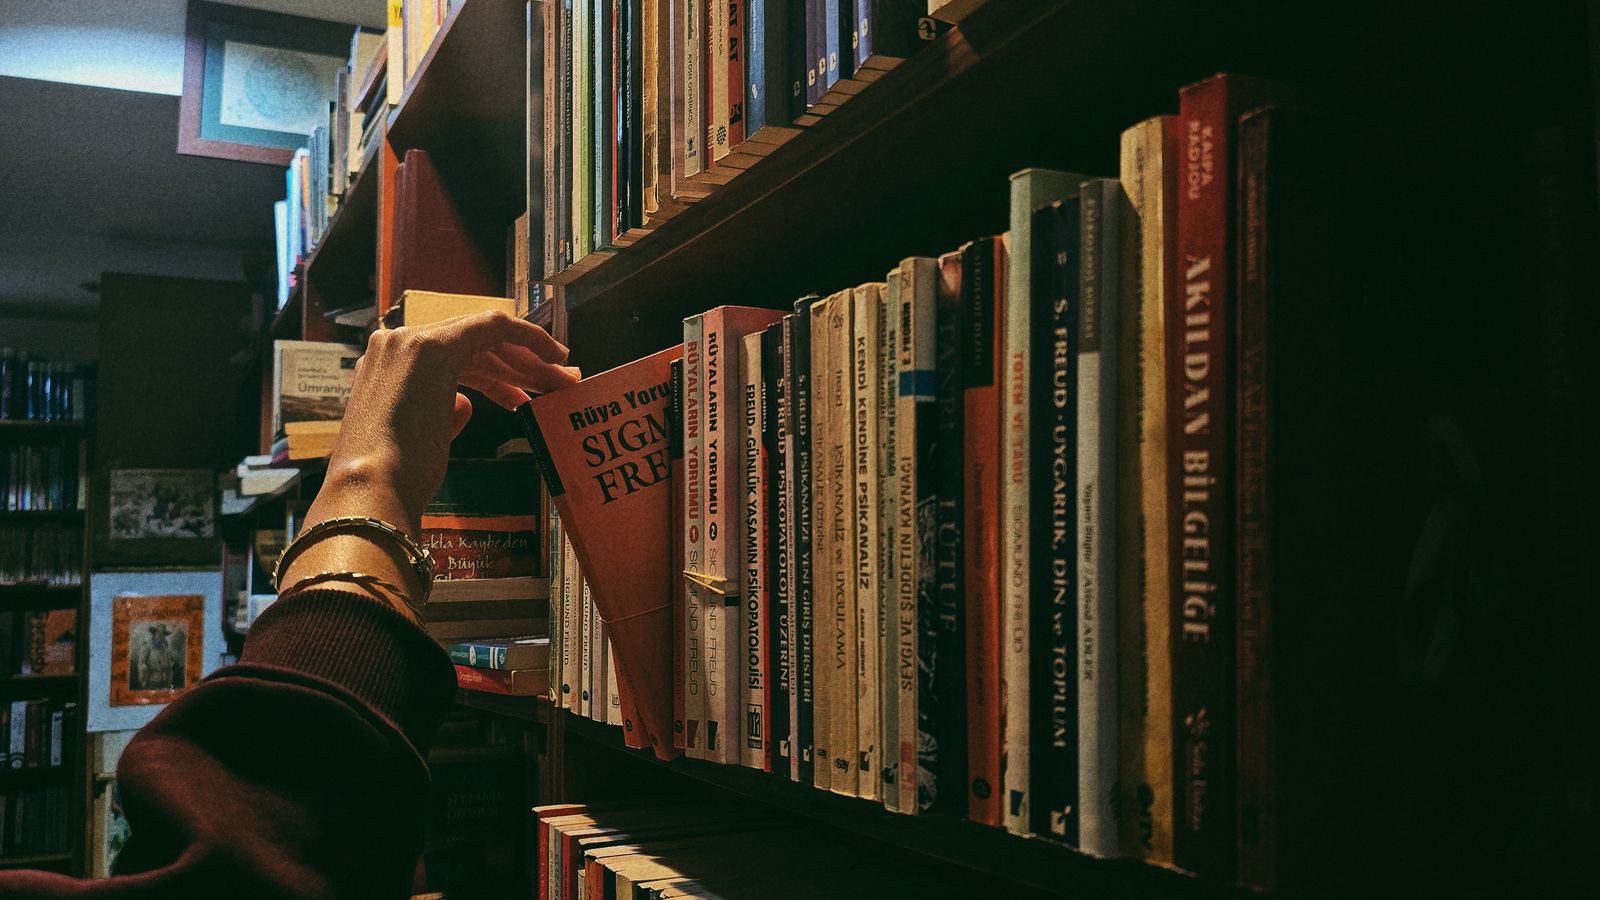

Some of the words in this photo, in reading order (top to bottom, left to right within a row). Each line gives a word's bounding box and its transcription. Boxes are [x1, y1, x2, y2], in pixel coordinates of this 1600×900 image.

[729, 37, 738, 63] AT
[1054, 298, 1069, 320] S.
[857, 336, 868, 391] KENDİ
[1053, 327, 1069, 408] FREUD
[1184, 256, 1213, 435] AKILDAN
[568, 400, 622, 432] Rüya
[623, 382, 672, 409] Yoru
[687, 341, 699, 438] RÜYALARIN
[708, 332, 719, 432] RÜYALARIN
[746, 384, 756, 426] FREUD
[1013, 352, 1024, 405] TOTEM
[582, 413, 672, 468] SIGM
[777, 398, 786, 454] FREUD
[798, 390, 807, 436] FREUD
[858, 397, 869, 475] KENDİNE
[1013, 412, 1024, 435] VE
[592, 449, 672, 504] FRE
[687, 445, 699, 520] YORUMU
[708, 439, 718, 515] YORUMU
[746, 437, 758, 494] GÜNLÜK
[1013, 441, 1024, 484] TABU
[1051, 424, 1068, 551] UYGARLIK,
[800, 451, 810, 545] PSİKANALİZE
[745, 499, 758, 564] YAŞAMIN
[858, 482, 871, 590] PSİKANALİZ
[1012, 505, 1024, 588] SIGMUND
[1182, 449, 1217, 643] BİLGELİĞE
[801, 552, 811, 584] YENİ
[939, 498, 960, 633] LÜTUF
[1053, 558, 1069, 606] DİN
[747, 569, 762, 690] PSİKOPATOLOJİSİ
[801, 589, 812, 629] GİRİŞ
[835, 570, 846, 670] UYGULAMA
[900, 619, 912, 637] VE
[1012, 594, 1024, 653] FREUD
[1053, 611, 1064, 637] ve
[689, 638, 698, 695] FREUD
[709, 637, 717, 696] FREUD
[779, 615, 790, 690] ÜZERİNE
[802, 634, 813, 703] DERSLERİ
[1084, 625, 1094, 681] ADLER
[1053, 643, 1068, 748] TOPLUM
